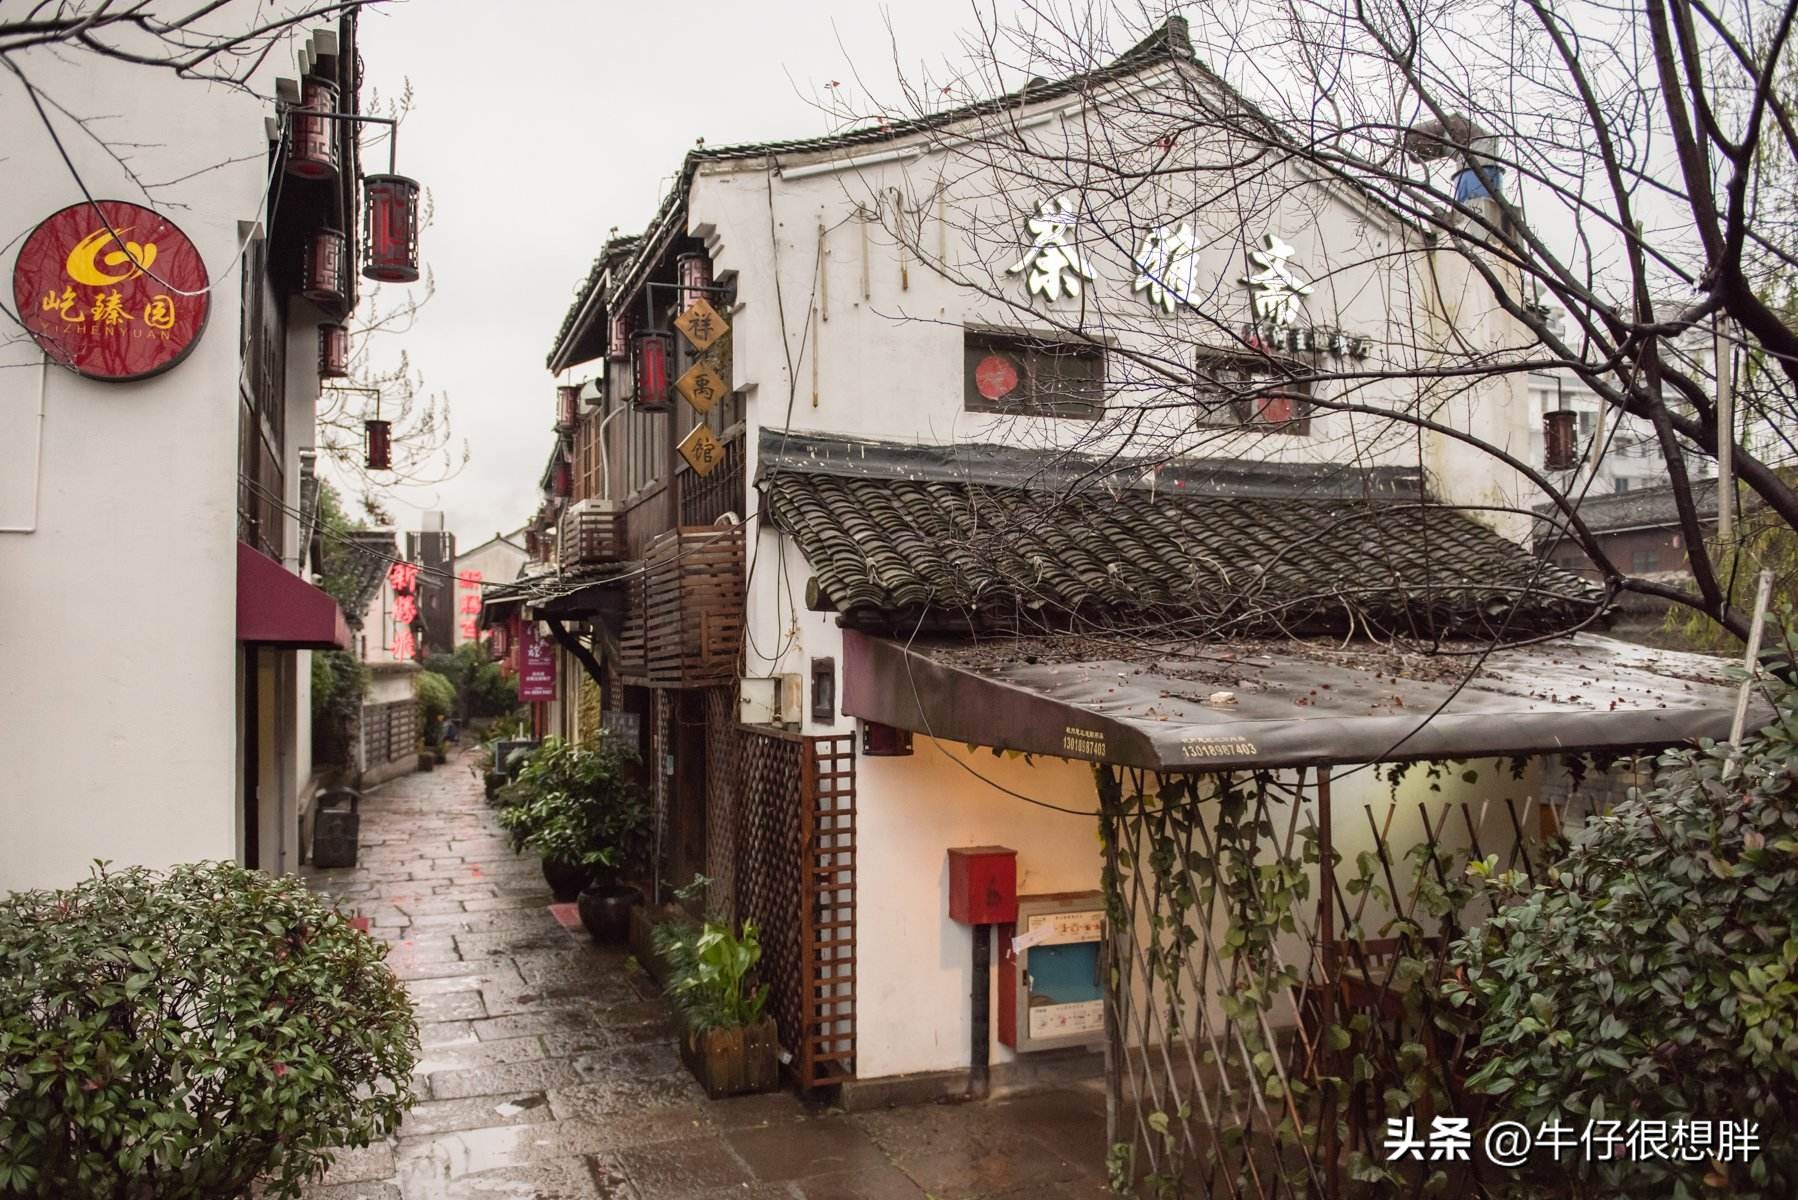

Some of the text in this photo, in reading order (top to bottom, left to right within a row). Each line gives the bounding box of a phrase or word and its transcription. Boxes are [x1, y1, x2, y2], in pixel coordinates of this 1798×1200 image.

[42, 285, 175, 329] 屹臻园
[41, 321, 170, 340] YIZHENYUAN
[1063, 736, 1106, 757] 13018987403
[1182, 743, 1257, 759] 13018987403
